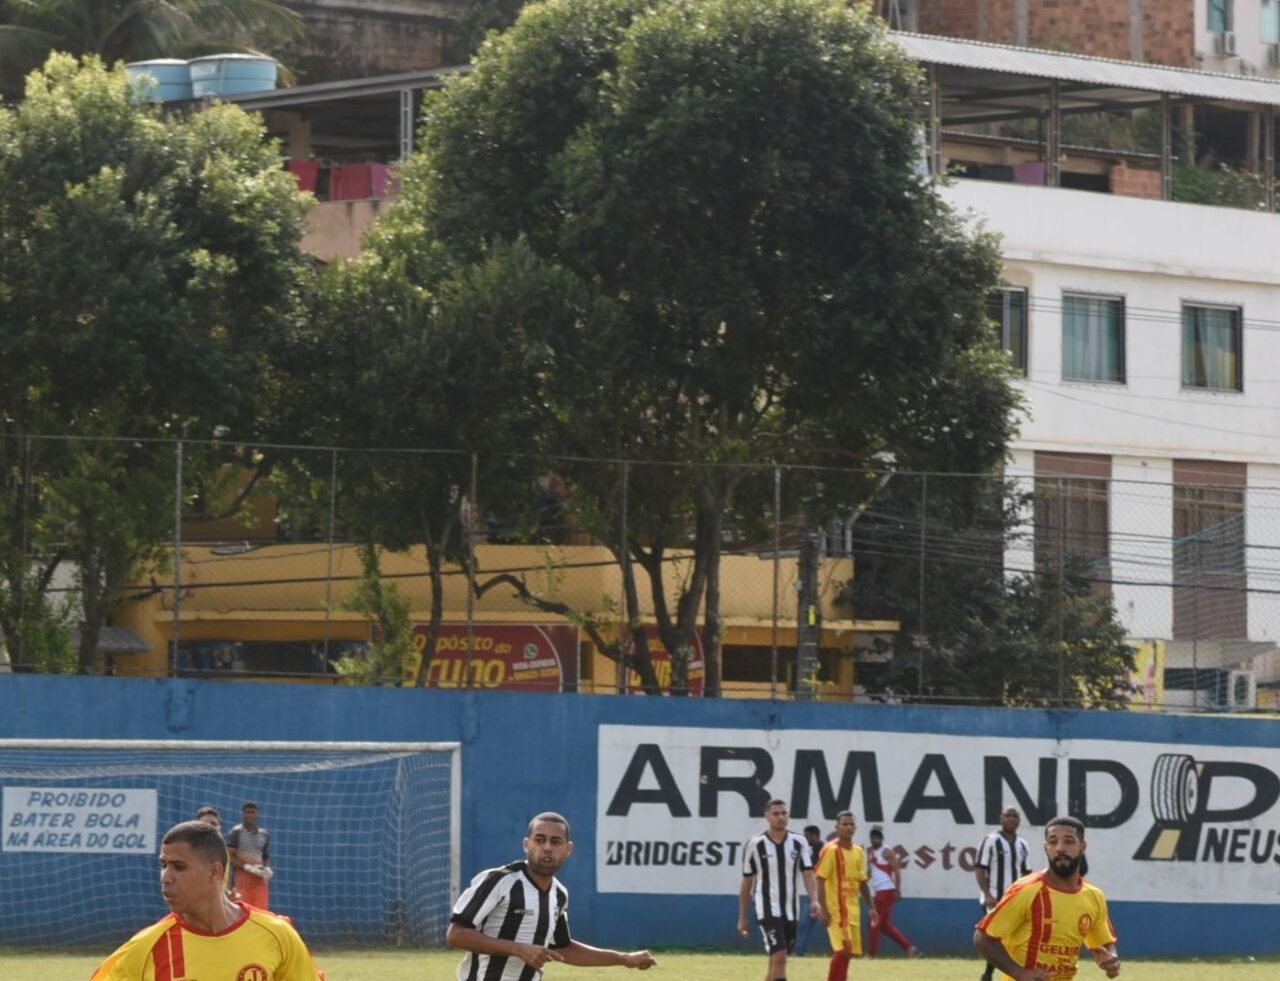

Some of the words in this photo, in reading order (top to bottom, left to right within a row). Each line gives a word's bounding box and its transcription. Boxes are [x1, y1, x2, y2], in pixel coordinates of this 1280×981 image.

[27, 791, 126, 808] PROIBIDO
[10, 812, 76, 828] BATER
[84, 813, 141, 828] BOLA
[6, 832, 29, 847] NA
[86, 833, 109, 848] DO
[112, 833, 147, 849] GOL
[606, 841, 741, 866] BRIDGEST
